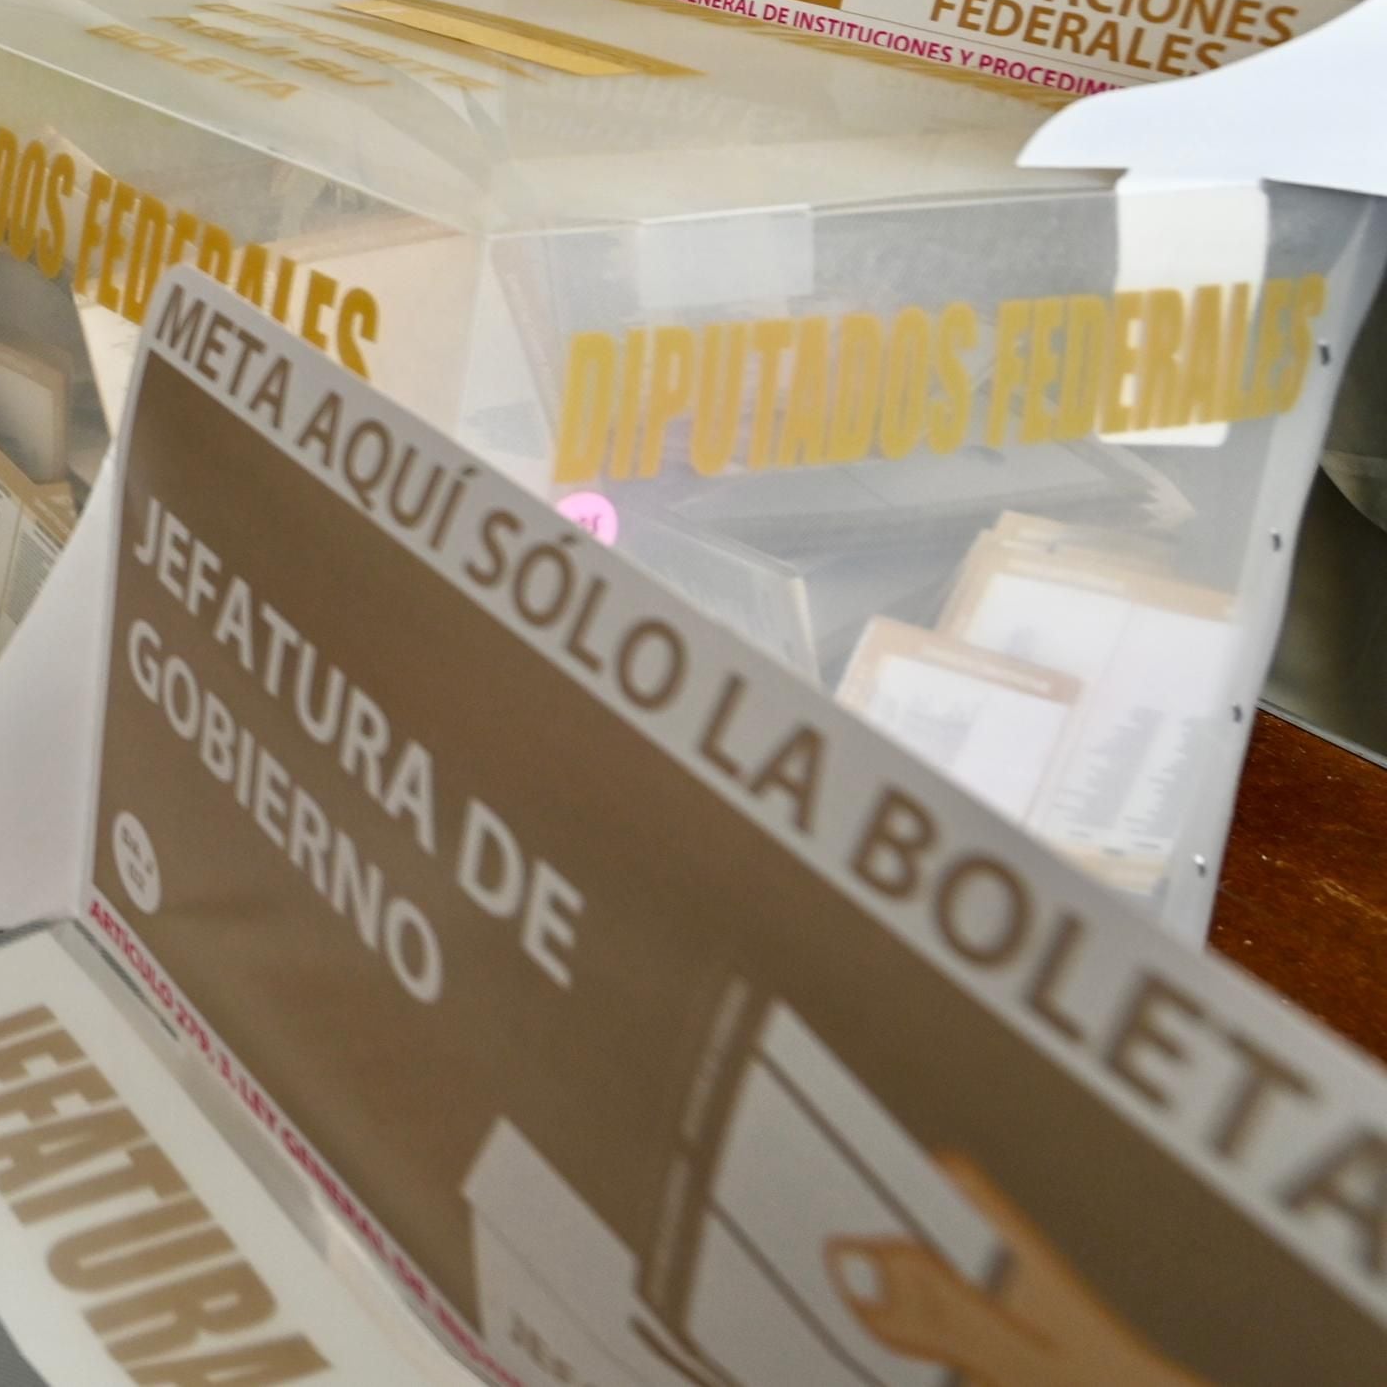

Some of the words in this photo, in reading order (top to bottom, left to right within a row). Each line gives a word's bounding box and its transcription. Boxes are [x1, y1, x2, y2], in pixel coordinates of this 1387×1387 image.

[762, 3, 790, 25] DE
[793, 10, 953, 64] INSTITUCIONES
[959, 47, 975, 67] Y
[553, 300, 981, 484] DIPUTADOS
[987, 271, 1327, 448] FEDERALES
[127, 615, 444, 1006] GOBIERNO
[132, 496, 439, 855] JEFATURA
[456, 795, 587, 991] DE
[155, 282, 294, 430] META
[296, 390, 478, 552] AQUÍ
[464, 507, 689, 713] SÓLO
[696, 672, 829, 837] LA
[851, 786, 1387, 1282] BOLETA
